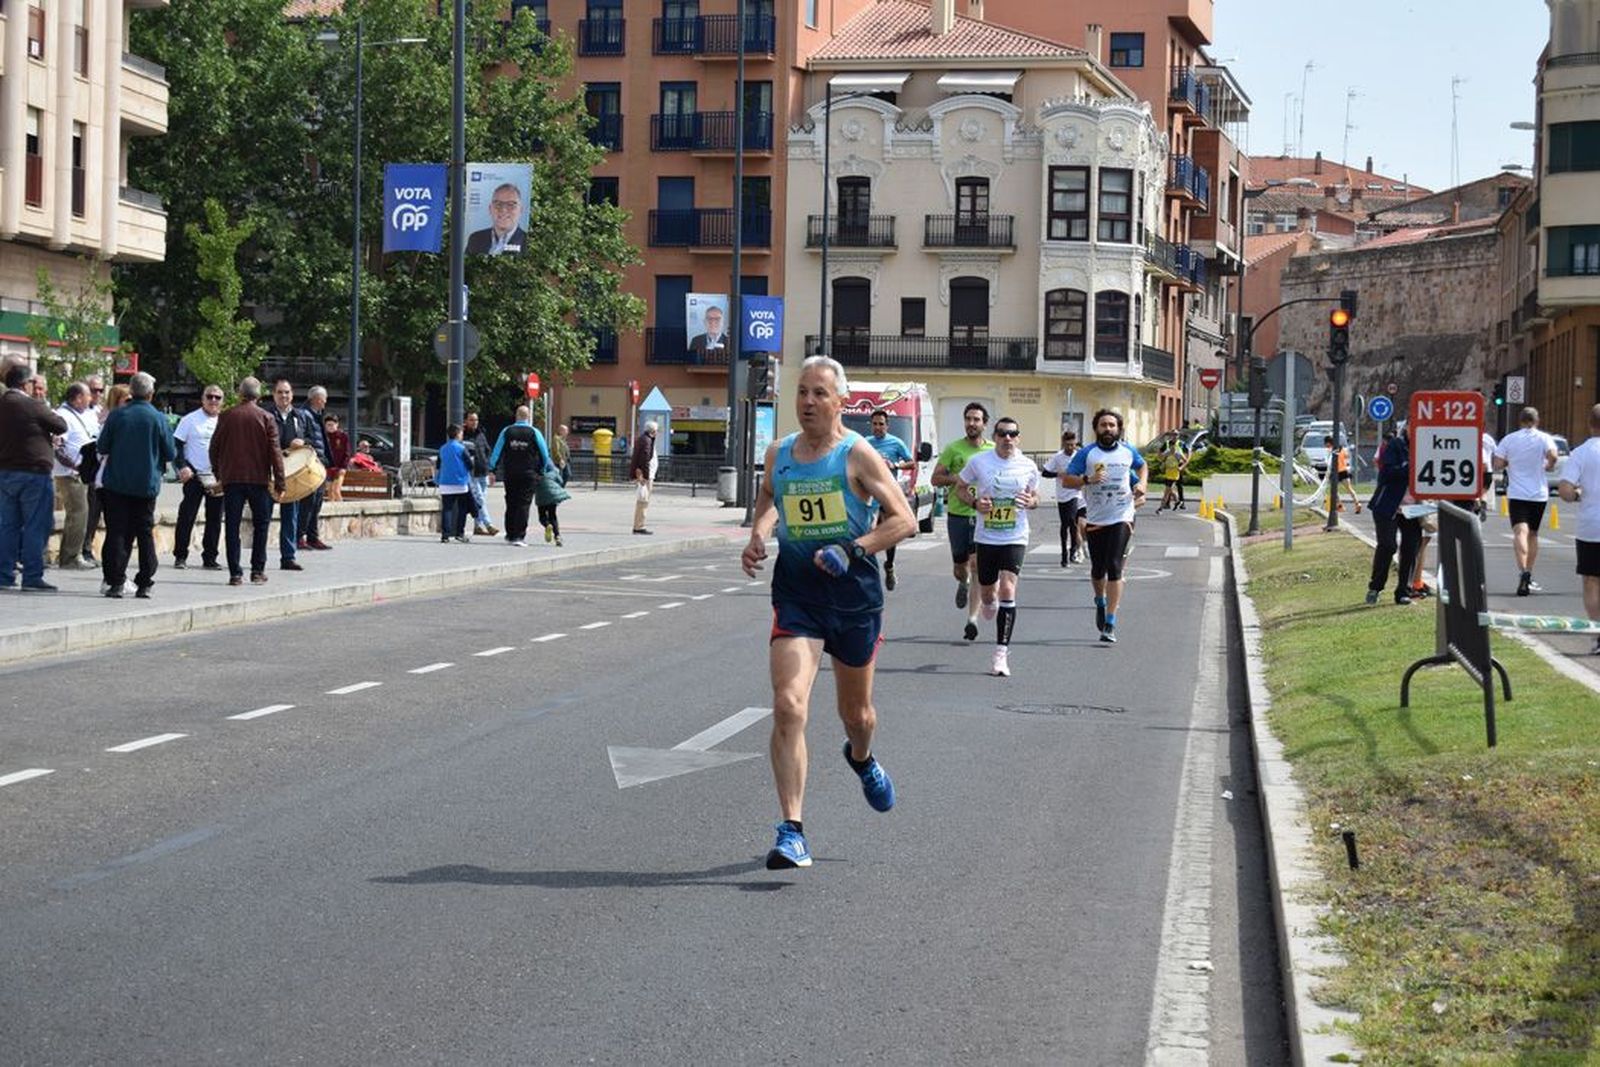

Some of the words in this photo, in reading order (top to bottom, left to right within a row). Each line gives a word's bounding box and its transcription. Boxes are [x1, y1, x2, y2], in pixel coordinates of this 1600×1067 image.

[395, 187, 432, 200] VOTA
[750, 310, 775, 320] VOTA
[1417, 400, 1477, 420] N-122
[1433, 434, 1461, 450] km
[1417, 459, 1475, 487] 459
[800, 498, 826, 521] 91
[989, 508, 1011, 520] 147
